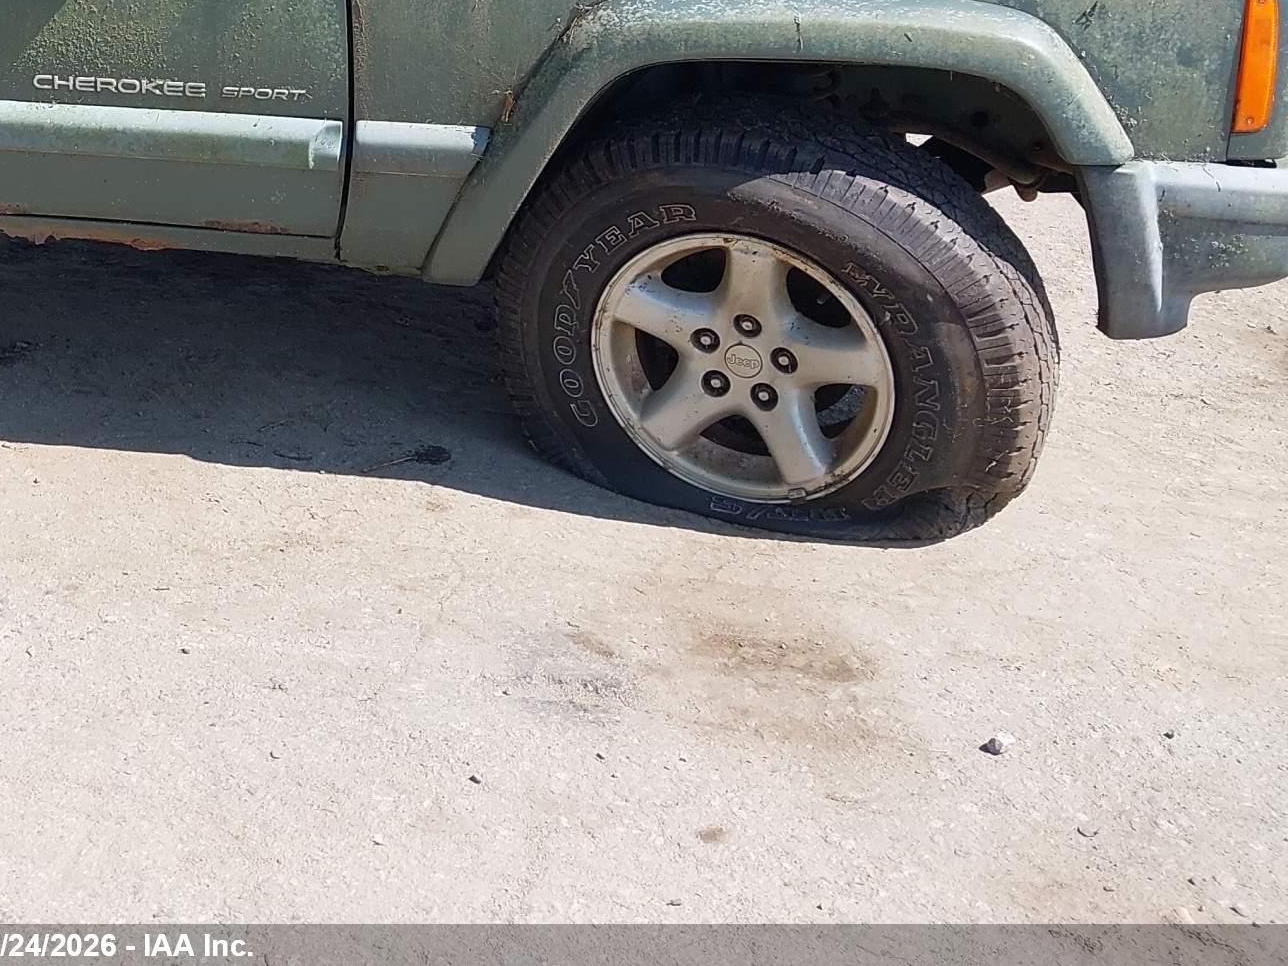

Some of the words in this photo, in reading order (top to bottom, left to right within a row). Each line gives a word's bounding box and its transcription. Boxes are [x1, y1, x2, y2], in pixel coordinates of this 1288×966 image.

[32, 74, 207, 98] CHEROKEE
[221, 86, 307, 101] SPORT
[727, 353, 760, 370] Jeep
[841, 261, 941, 511] WRANGLER
